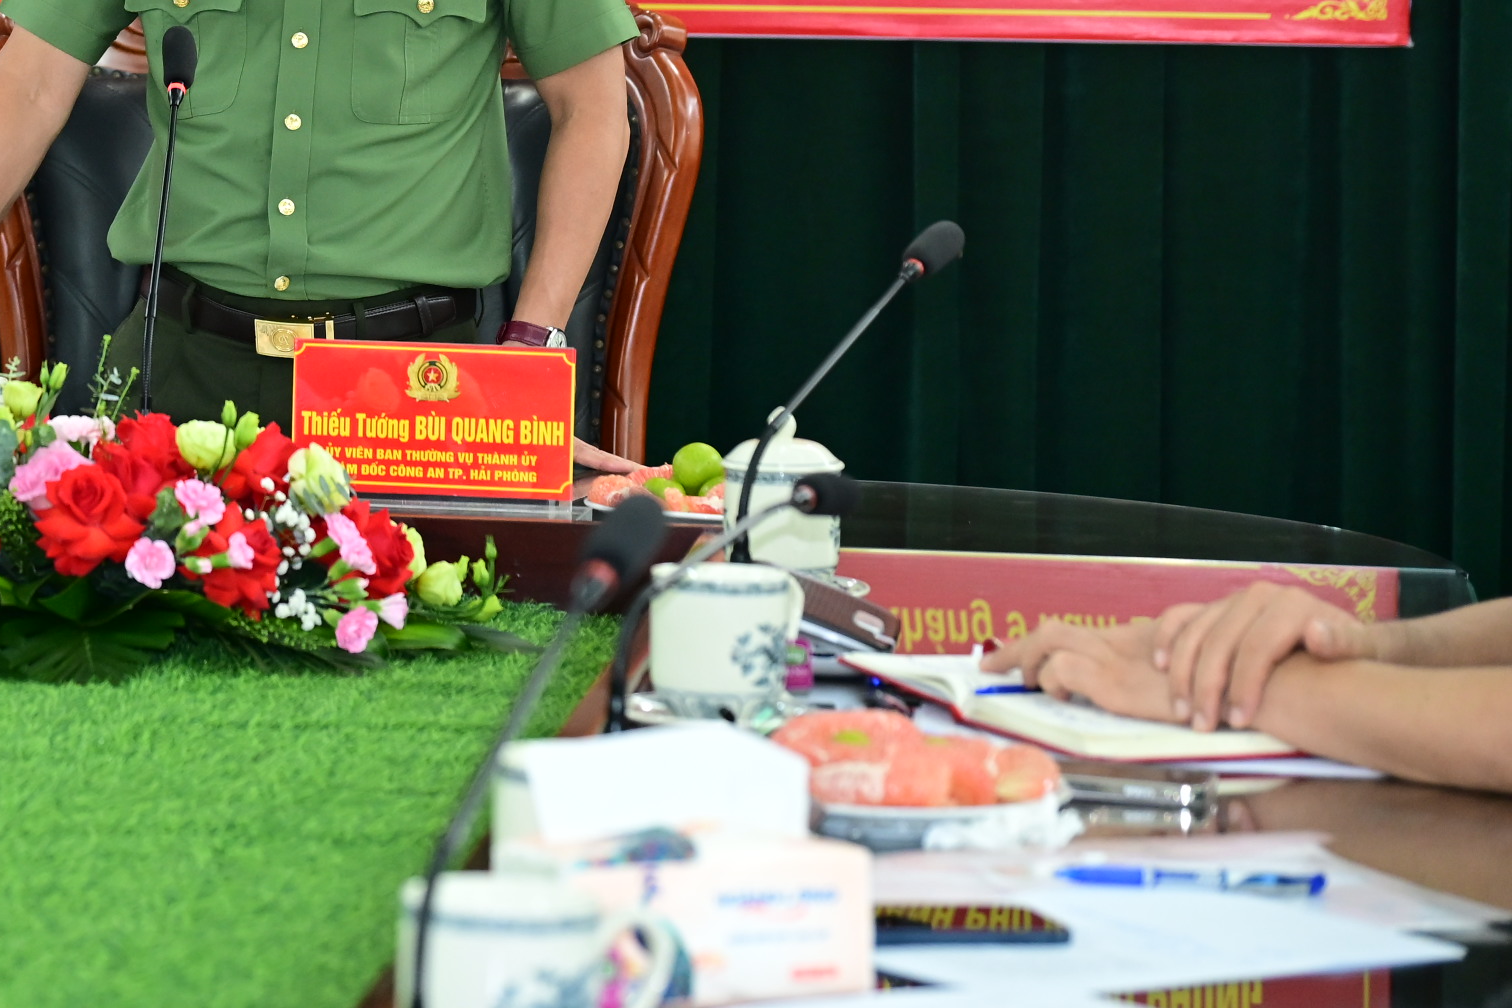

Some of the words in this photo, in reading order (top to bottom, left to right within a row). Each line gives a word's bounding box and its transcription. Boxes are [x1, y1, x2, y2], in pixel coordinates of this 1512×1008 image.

[302, 408, 350, 437] Thiếu
[356, 412, 409, 442] Tướng
[415, 411, 446, 441] BÙI
[452, 416, 514, 445] QUANG
[520, 415, 565, 446] BÌNH
[326, 442, 341, 458] ỦY
[345, 446, 374, 459] VIÊN
[377, 448, 402, 460] BAN
[405, 447, 454, 463] THƯỜNG
[458, 451, 474, 466] VỤ
[477, 449, 518, 466] THÀNH
[521, 450, 538, 466] ỦY
[361, 462, 387, 476] ĐỐC
[389, 464, 424, 478] CÔNG
[427, 467, 444, 479] AN
[448, 468, 467, 480] TP.
[470, 466, 491, 481] HẢI
[494, 468, 538, 483] PHÒNG
